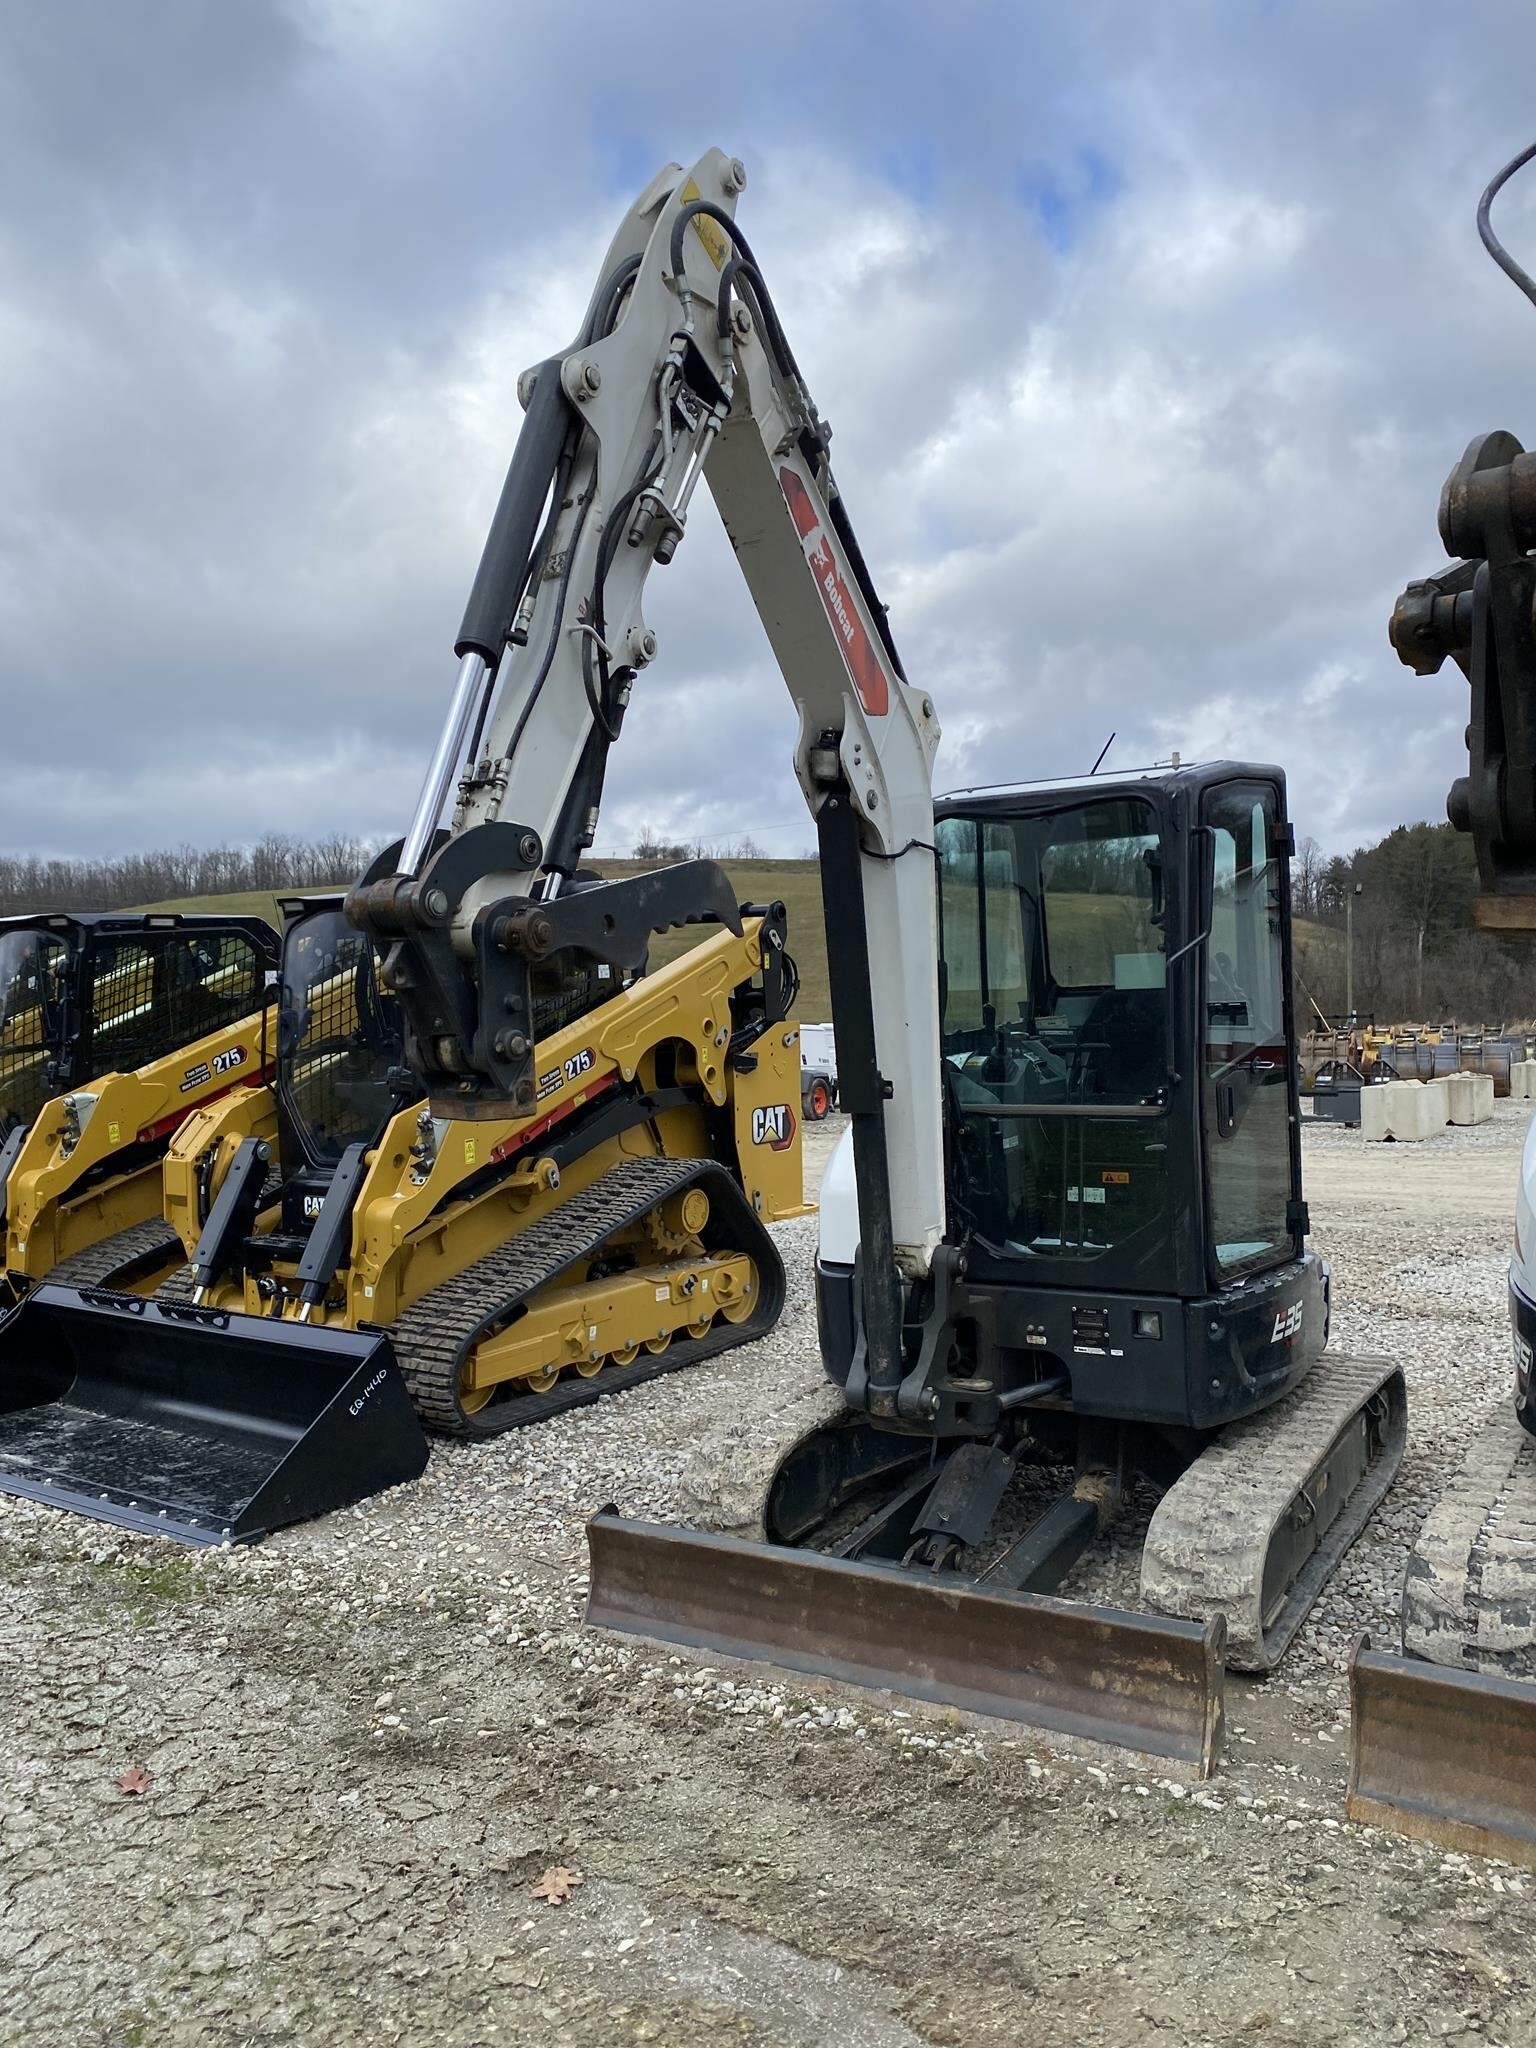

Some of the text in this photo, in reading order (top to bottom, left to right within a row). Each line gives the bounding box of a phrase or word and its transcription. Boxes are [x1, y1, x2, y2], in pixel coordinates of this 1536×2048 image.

[824, 571, 854, 643] Bobcat
[213, 1048, 241, 1074] 275
[565, 1050, 590, 1080] 275
[752, 1105, 786, 1144] CAT
[304, 1196, 325, 1216] CAT
[1270, 1299, 1303, 1344] E35
[349, 1369, 387, 1416] EQ-1440
